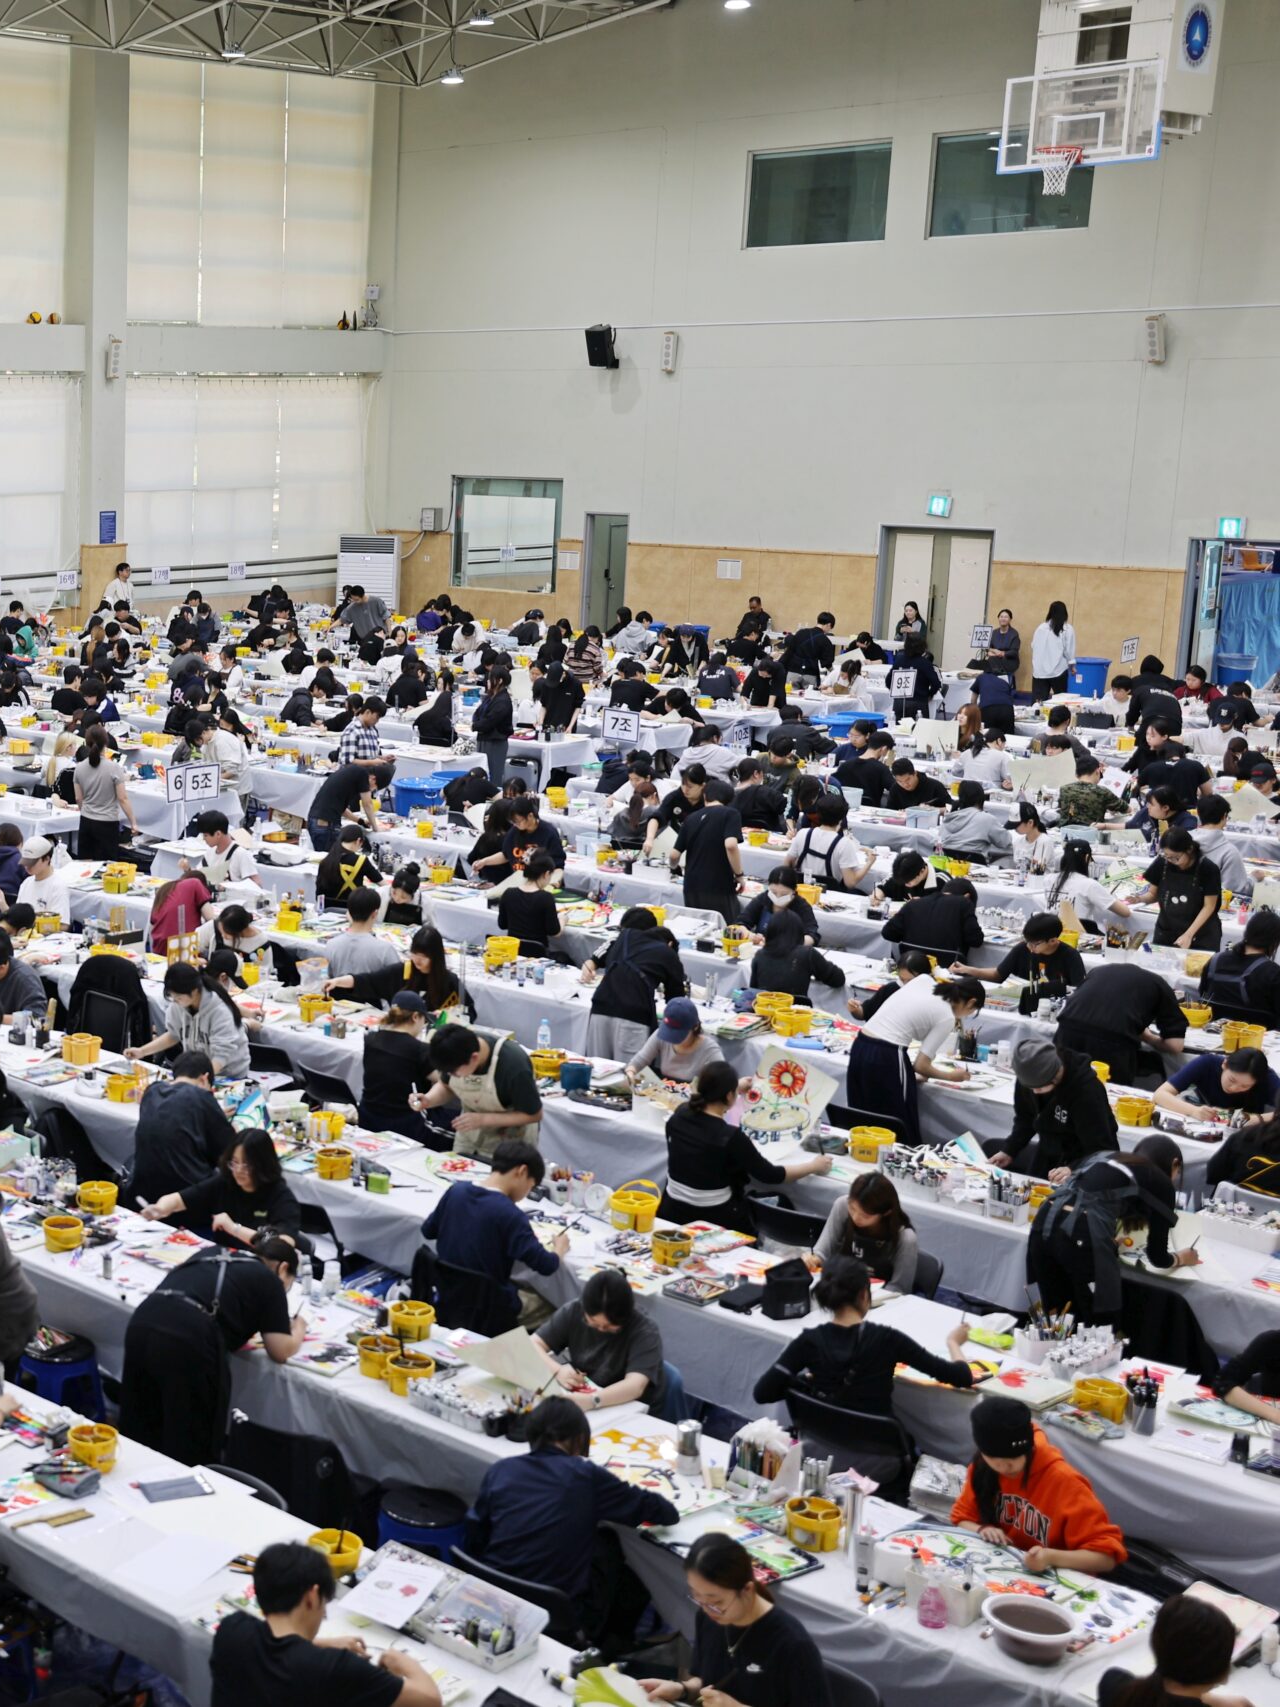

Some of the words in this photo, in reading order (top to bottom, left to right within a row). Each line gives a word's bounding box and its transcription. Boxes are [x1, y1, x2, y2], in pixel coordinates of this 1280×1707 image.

[154, 569, 169, 581] 17행
[230, 564, 245, 576] 18행
[59, 573, 75, 585] 16행
[974, 630, 989, 642] 12조
[896, 676, 911, 689] 9조
[611, 716, 632, 733] 7조
[734, 728, 749, 741] 10조
[191, 772, 213, 790] 5조
